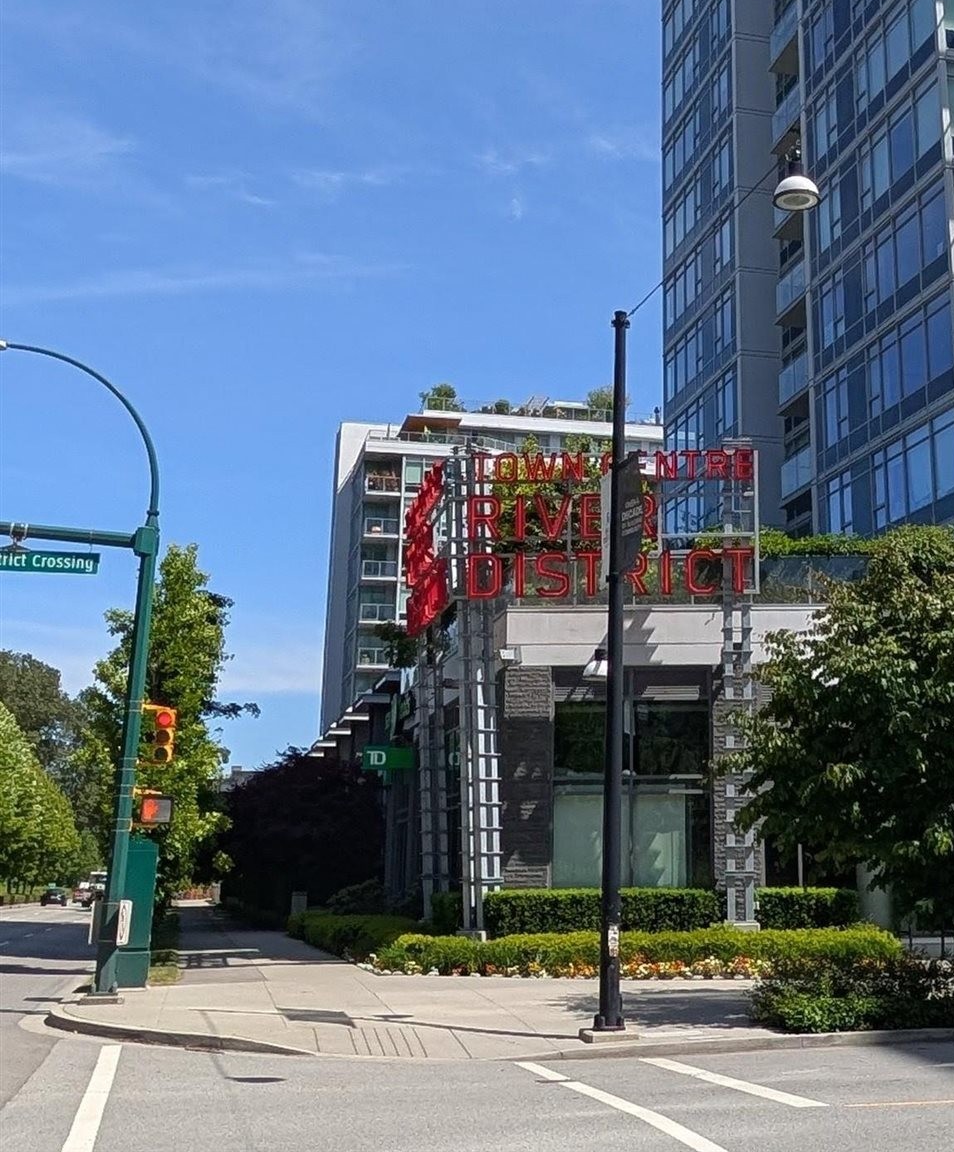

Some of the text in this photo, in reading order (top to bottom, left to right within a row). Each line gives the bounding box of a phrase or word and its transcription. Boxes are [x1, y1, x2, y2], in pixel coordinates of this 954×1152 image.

[474, 451, 582, 481] TOWN
[32, 554, 94, 573] Crossing
[466, 550, 756, 598] DISTRICT
[366, 750, 387, 766] TD
